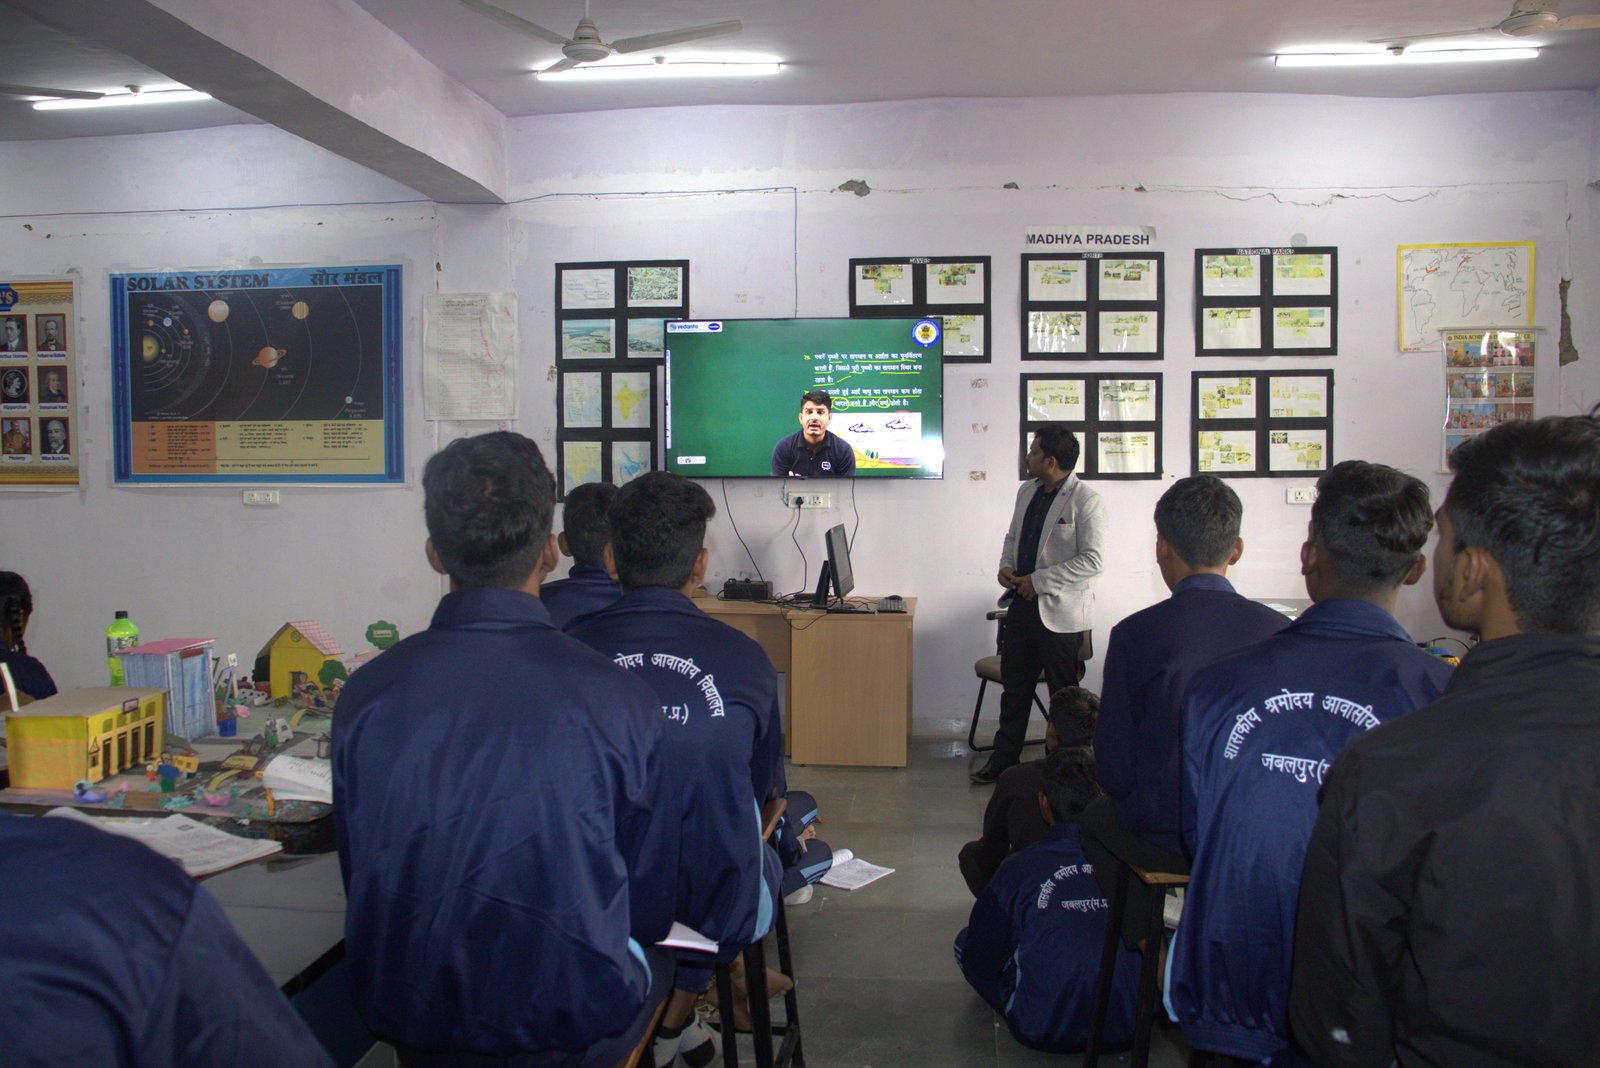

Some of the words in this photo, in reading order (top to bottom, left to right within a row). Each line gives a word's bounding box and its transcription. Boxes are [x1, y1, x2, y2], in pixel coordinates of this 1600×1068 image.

[1026, 234, 1082, 244] MADHYA
[1086, 234, 1150, 245] PRADESH
[127, 276, 188, 291] SOLAR
[193, 273, 270, 289] SYSTEM
[310, 269, 339, 286] सौर
[343, 268, 384, 284] मंडल
[651, 653, 702, 680] आवासीय
[696, 674, 725, 718] विद्यालय
[1224, 707, 1262, 760] शासकीय
[1264, 688, 1314, 714] श्रमोदय
[1322, 695, 1382, 732] आवासीय
[1037, 878, 1056, 909] शासकीय
[1054, 866, 1078, 880] श्रमोदय
[1082, 864, 1095, 874] आ
